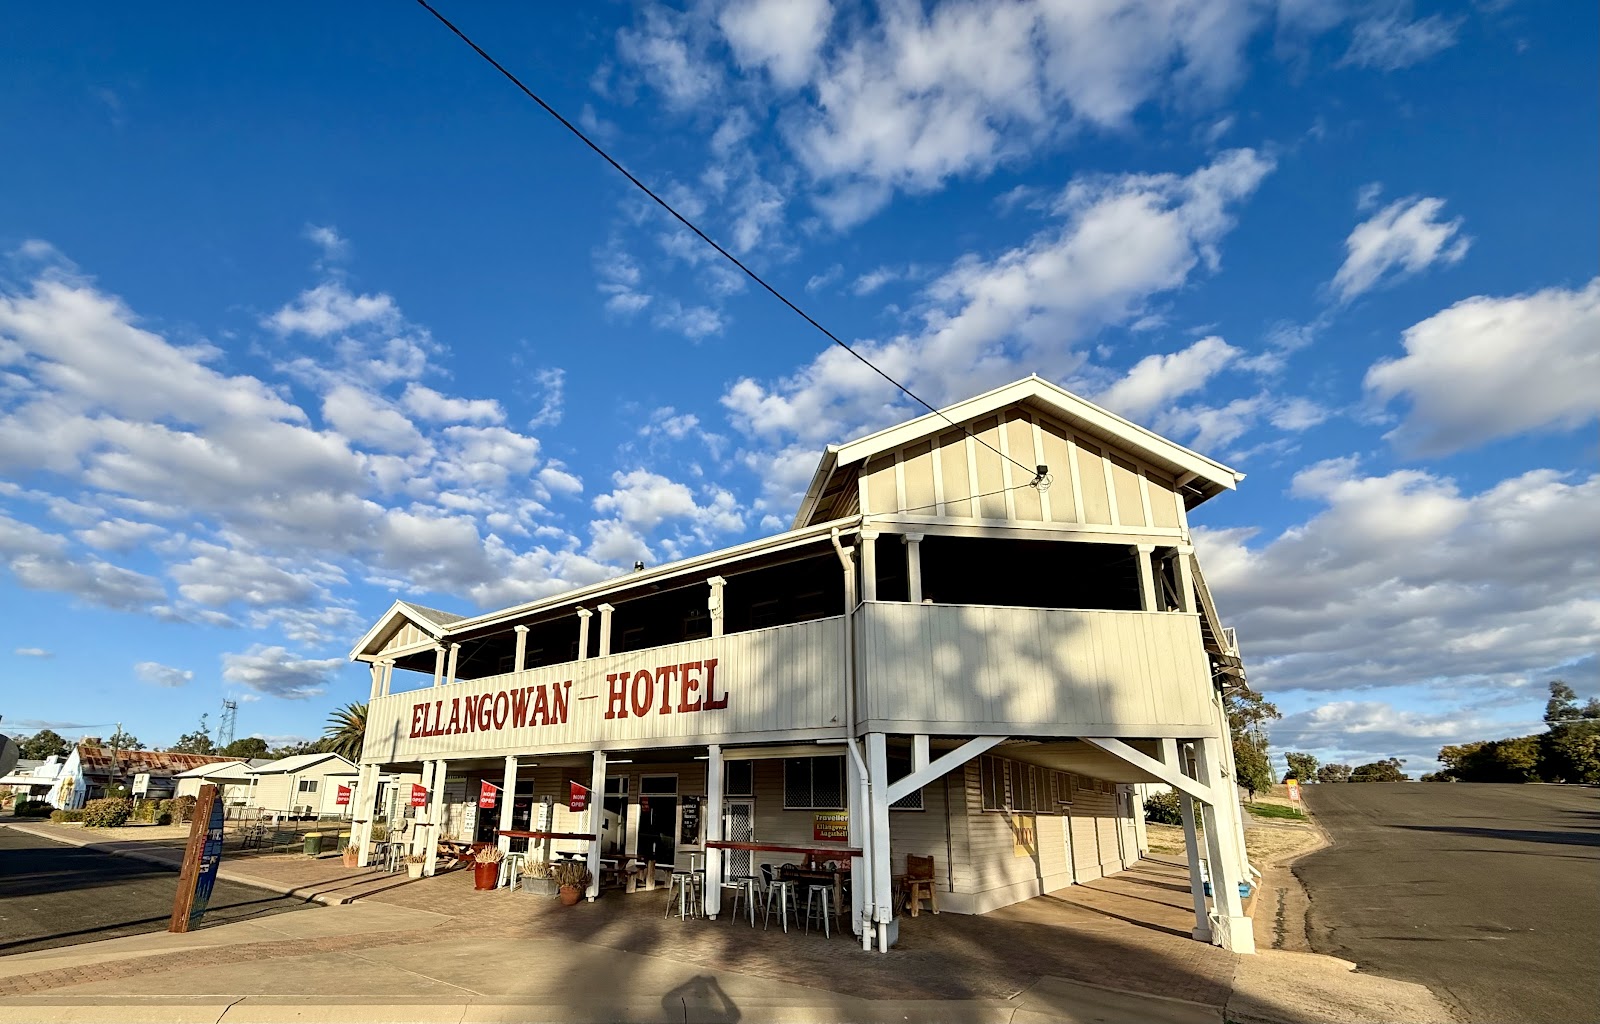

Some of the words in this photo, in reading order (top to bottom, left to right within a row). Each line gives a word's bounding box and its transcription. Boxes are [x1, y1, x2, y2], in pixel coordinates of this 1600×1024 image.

[409, 680, 573, 739] ELLANGOWAN
[604, 658, 729, 720] HOTEL
[816, 824, 847, 832] Ellangowa
